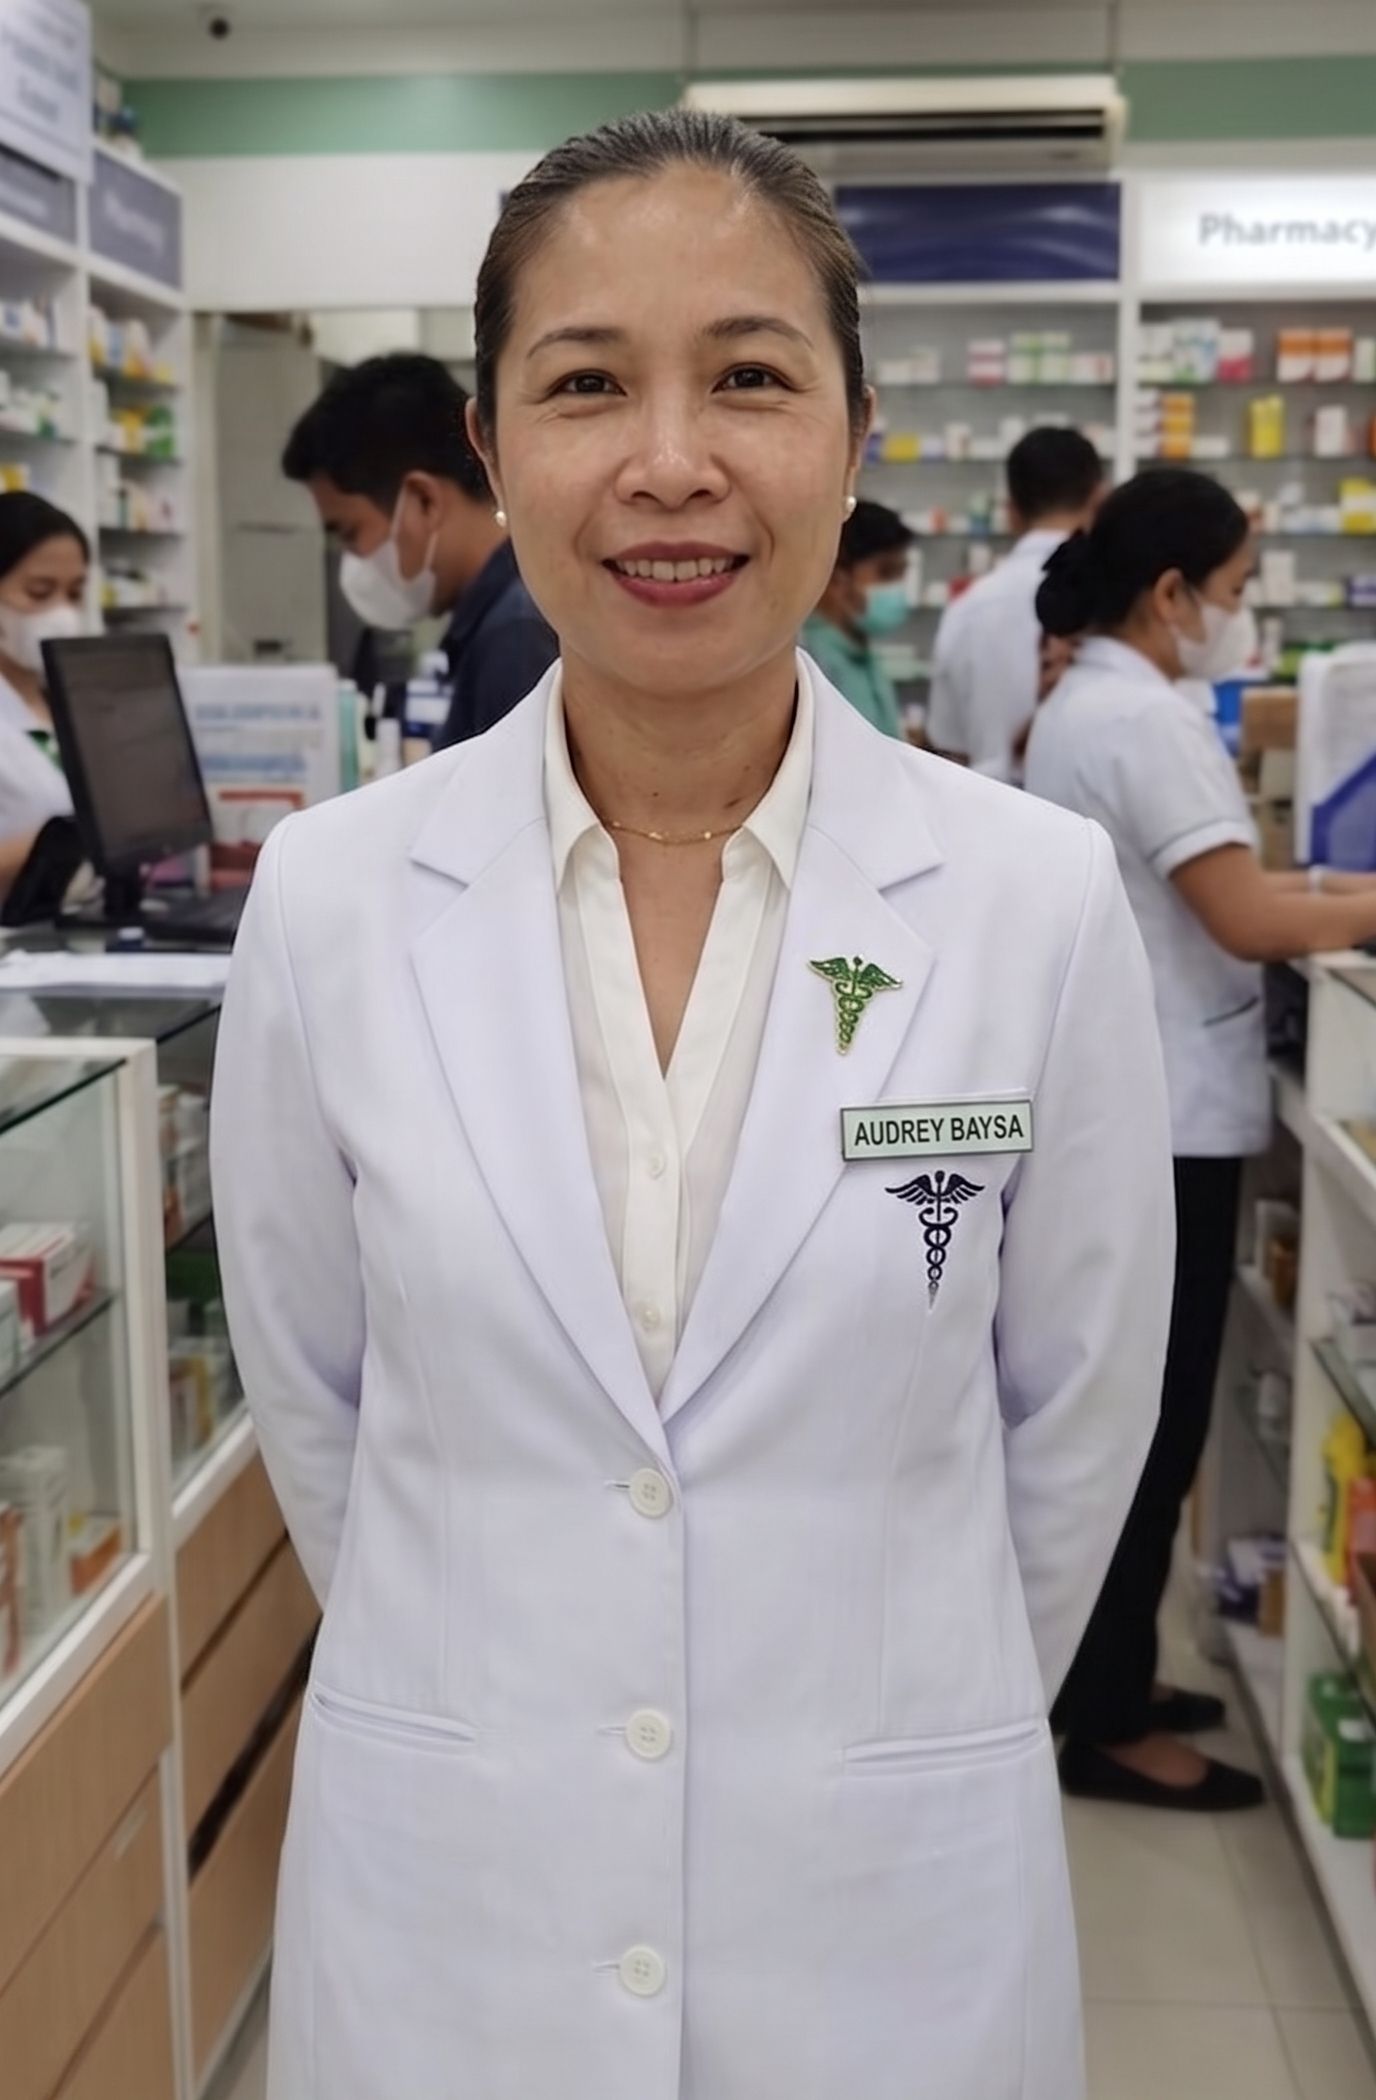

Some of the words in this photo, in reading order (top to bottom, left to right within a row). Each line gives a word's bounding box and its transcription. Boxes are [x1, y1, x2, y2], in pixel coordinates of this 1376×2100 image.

[1199, 212, 1376, 253] Pharmacy
[854, 1117, 945, 1147] AUDREY
[950, 1113, 1025, 1142] BAYSA
